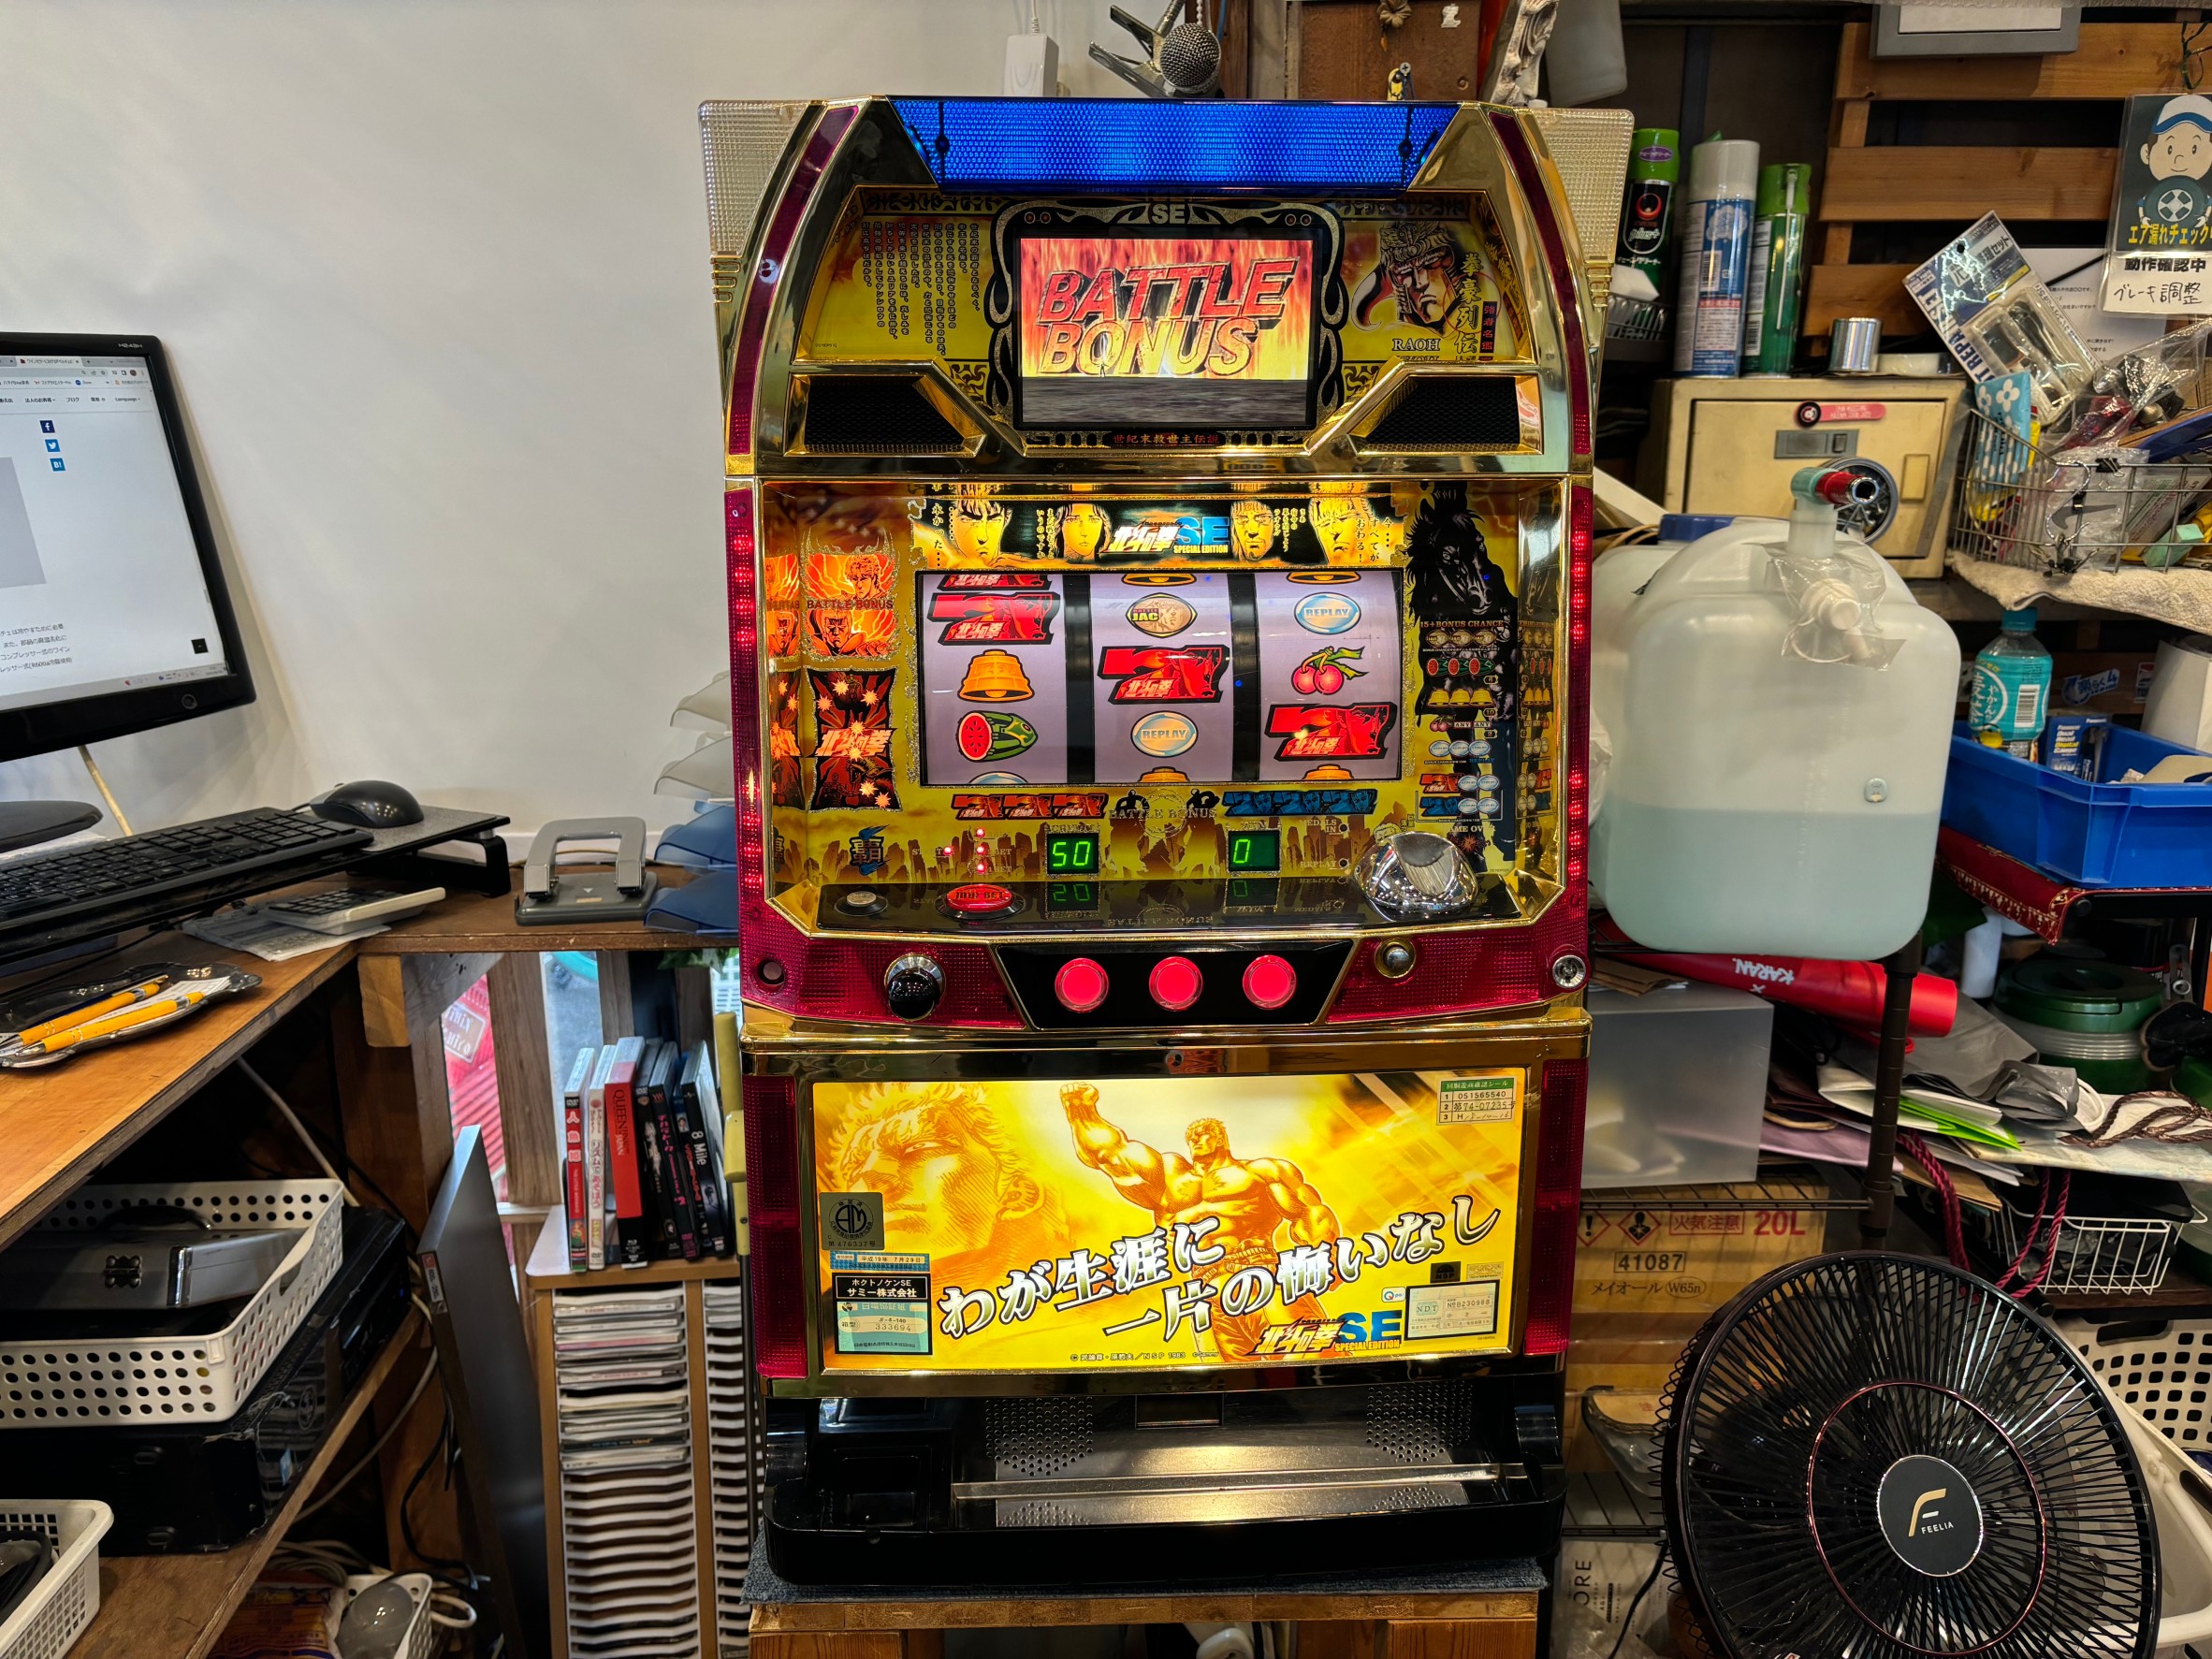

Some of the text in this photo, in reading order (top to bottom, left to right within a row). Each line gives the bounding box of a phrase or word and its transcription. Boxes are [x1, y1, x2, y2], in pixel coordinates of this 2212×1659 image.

[1151, 203, 1187, 224] SE
[2128, 224, 2212, 245] エア漏れチェック
[2124, 257, 2206, 273] 動作確認中
[1036, 255, 1302, 325] BATTLE
[1455, 253, 1483, 354] 拳豪列伝
[1037, 316, 1260, 377] BONUS
[1393, 338, 1441, 352] RAOH
[1113, 434, 1220, 444] 世紀末救世主伝説
[1175, 516, 1230, 546] SE
[1369, 517, 1379, 561] すべてが
[1173, 545, 1229, 554] SPECIAL EDITION
[808, 599, 894, 609] BATTLE BONUS
[1132, 612, 1159, 622] JAC
[1305, 608, 1350, 618] REPLAY
[1467, 619, 1505, 628] CHANCE
[1142, 729, 1186, 740] REPLAY
[1108, 808, 1217, 819] BATTLE BONUS
[1052, 840, 1091, 867] 50
[1232, 838, 1251, 865] 0
[983, 890, 1005, 899] BET
[691, 1130, 704, 1141] 8
[693, 1142, 709, 1166] Mile
[1673, 1214, 1741, 1230] 火気注意
[1753, 1211, 1807, 1236] 20L
[1102, 1195, 1502, 1343] 一片の悔いなし
[1618, 1253, 1684, 1271] 41087
[851, 1278, 912, 1288] ホクトノケンSE
[937, 1216, 1226, 1340] わが生涯に
[847, 1288, 918, 1298] サミー株式会社
[1591, 1281, 1702, 1296] メイオール W65n
[1417, 1304, 1439, 1314] NDT
[875, 1323, 911, 1332] 333694
[1337, 1310, 1404, 1342] SE
[1254, 1320, 1345, 1355] 北斗の拳
[1334, 1339, 1400, 1353] SPECIAL EDITION
[1167, 1351, 1186, 1360] 1983
[1921, 1521, 1955, 1535] FEELIA
